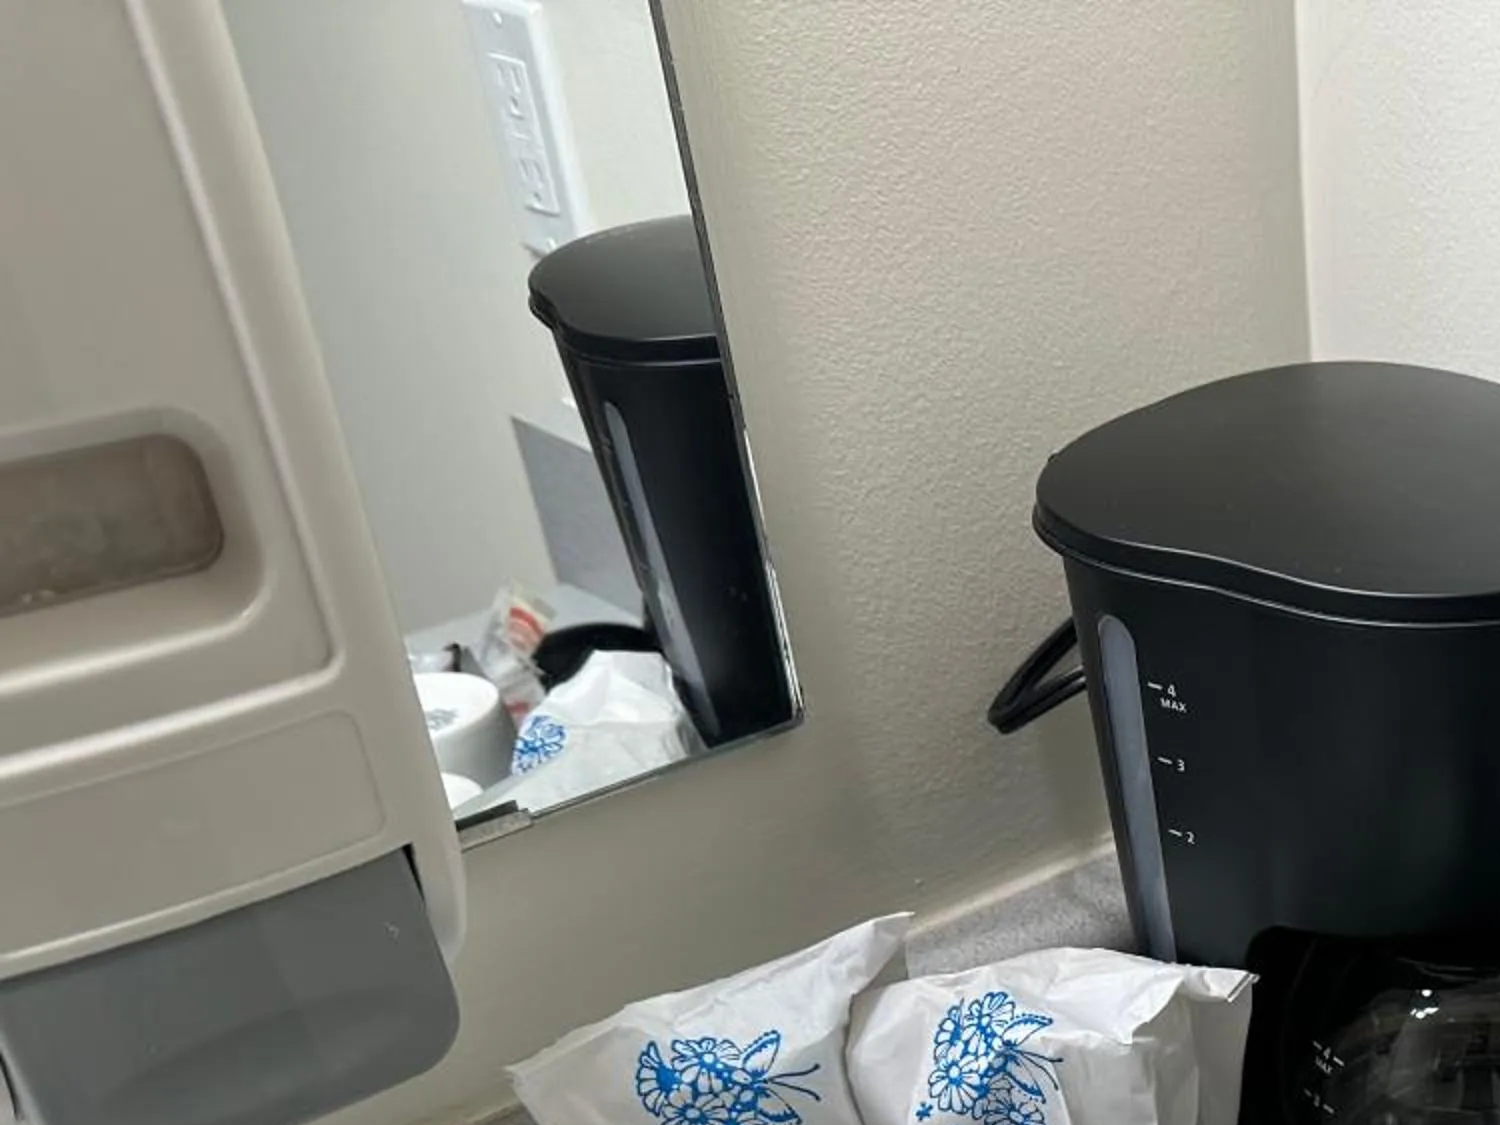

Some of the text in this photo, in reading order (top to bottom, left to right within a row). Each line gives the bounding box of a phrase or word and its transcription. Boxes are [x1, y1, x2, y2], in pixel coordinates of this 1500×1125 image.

[1160, 697, 1188, 713] MAX
[1177, 759, 1186, 772] 3
[1186, 831, 1196, 845] 2
